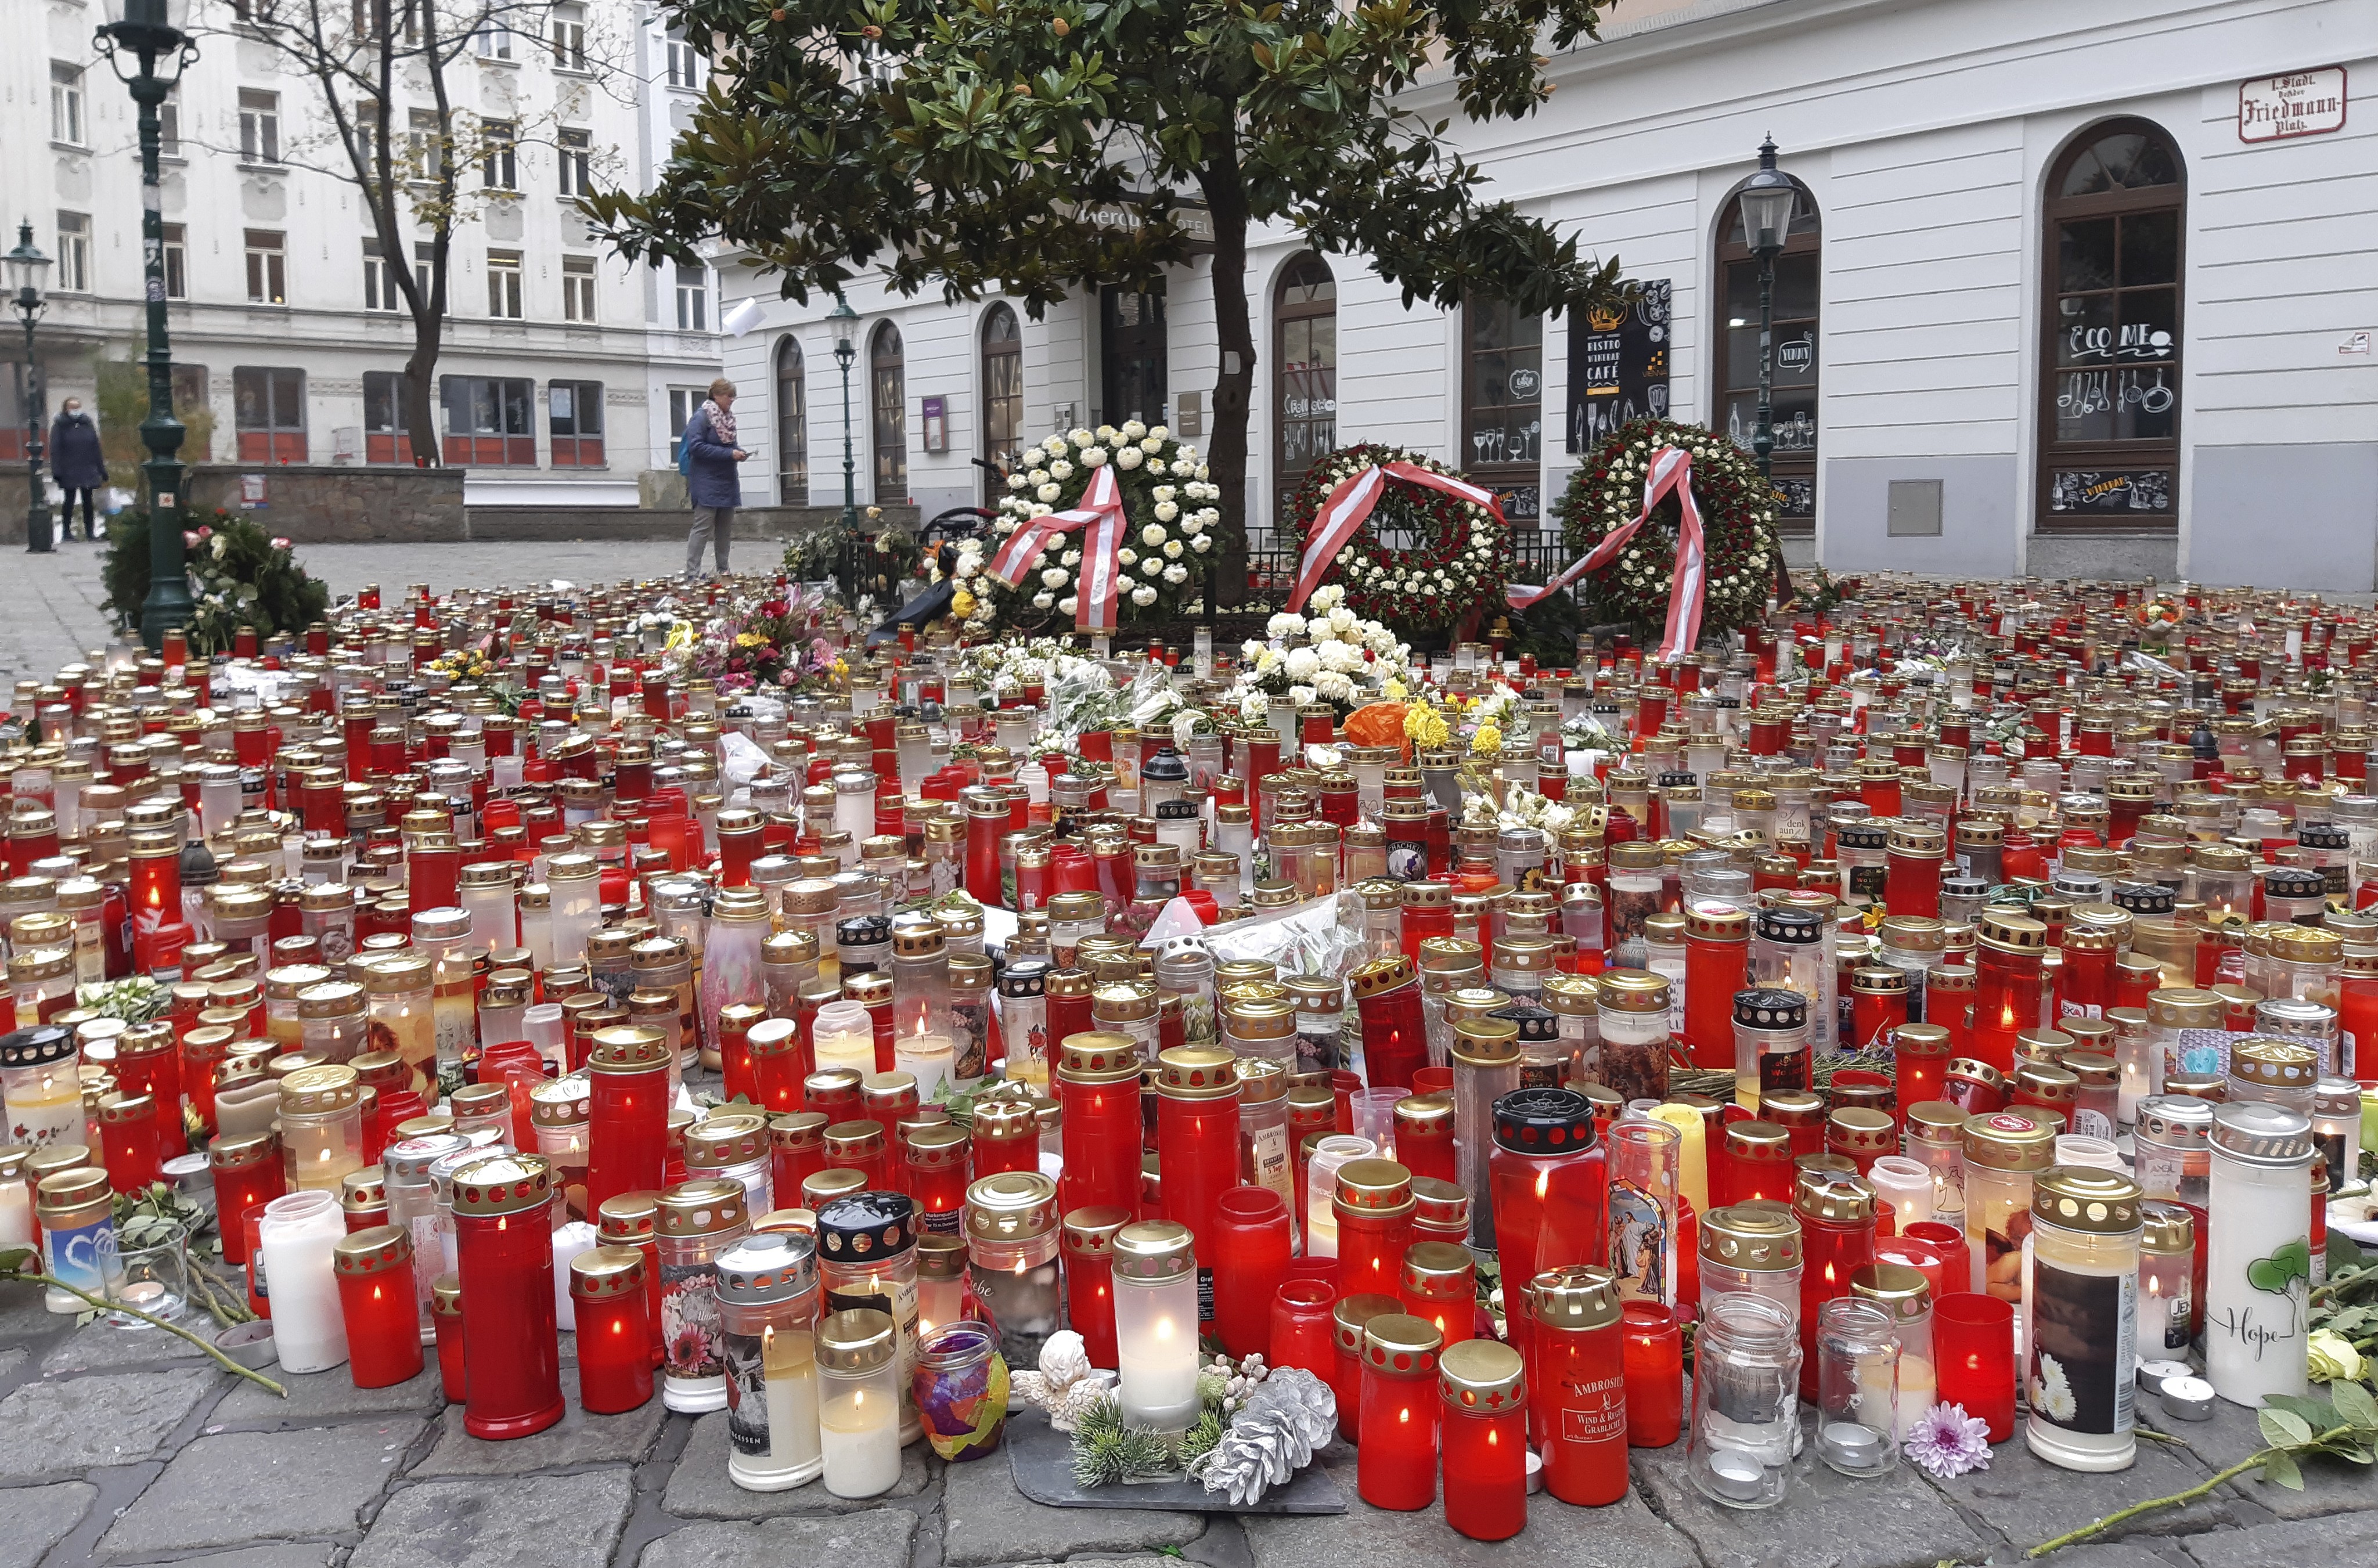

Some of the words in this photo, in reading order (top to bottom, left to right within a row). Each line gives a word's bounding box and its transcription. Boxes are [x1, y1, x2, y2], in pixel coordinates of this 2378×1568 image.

[1177, 219, 1210, 235] OTEL
[1587, 340, 1620, 352] BISTRO
[1587, 361, 1619, 380] CAFÉ
[1771, 489, 1788, 502] STRO
[1787, 819, 1806, 828] denk
[1619, 944, 1646, 957] Gedenk
[1838, 1000, 1853, 1009] EK
[2062, 1005, 2082, 1018] EKA
[971, 1277, 994, 1297] iebe
[2173, 1300, 2190, 1315] JE
[698, 1311, 721, 1321] Unver
[2227, 1306, 2281, 1362] Hope
[1574, 1372, 1625, 1397] AMBROSIUS
[1577, 1414, 1598, 1425] WIND
[1599, 1413, 1606, 1423] &
[1584, 1419, 1621, 1434] GRABLICHT
